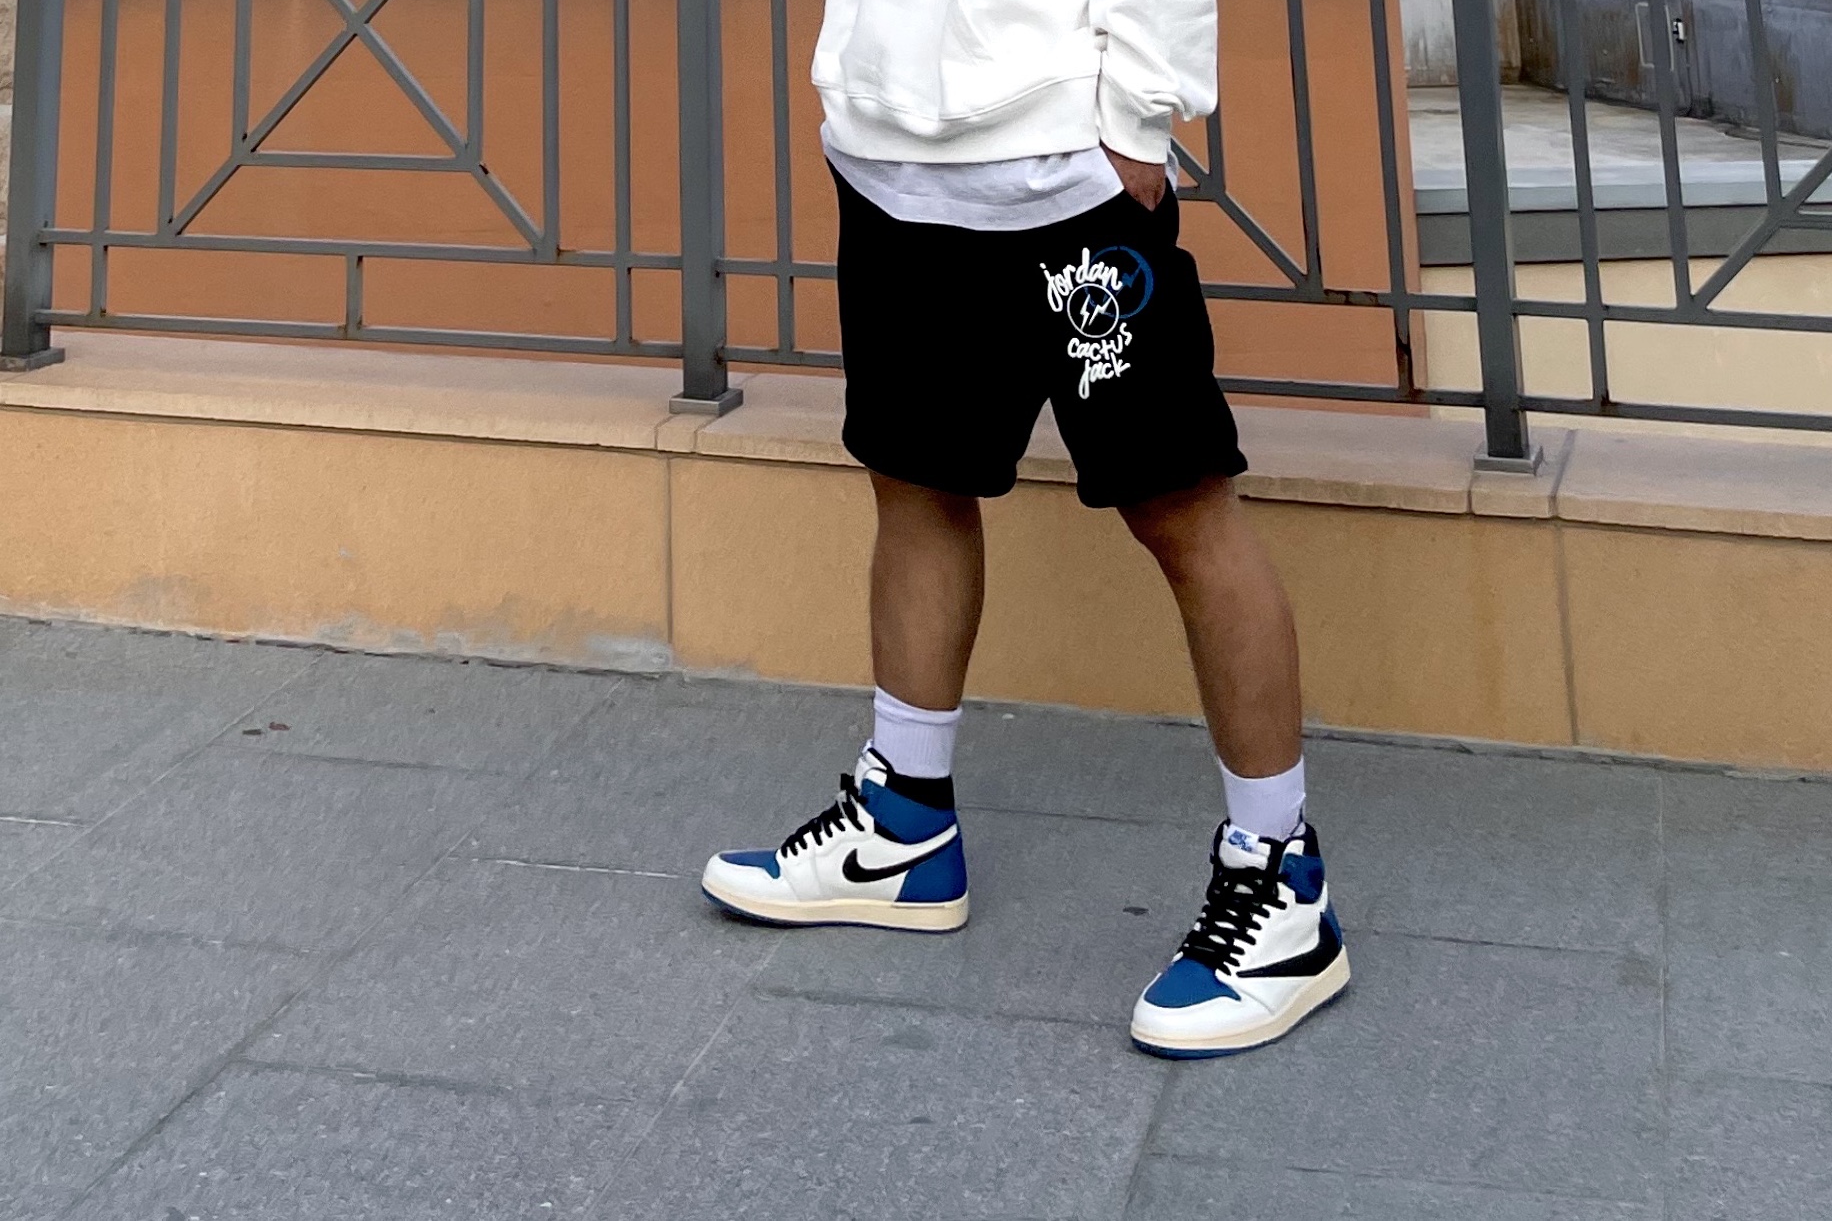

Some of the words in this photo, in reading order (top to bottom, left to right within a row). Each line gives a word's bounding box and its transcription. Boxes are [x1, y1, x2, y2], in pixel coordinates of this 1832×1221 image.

[1039, 247, 1123, 312] jordan
[1067, 322, 1133, 361] cactus
[1078, 352, 1131, 399] jack
